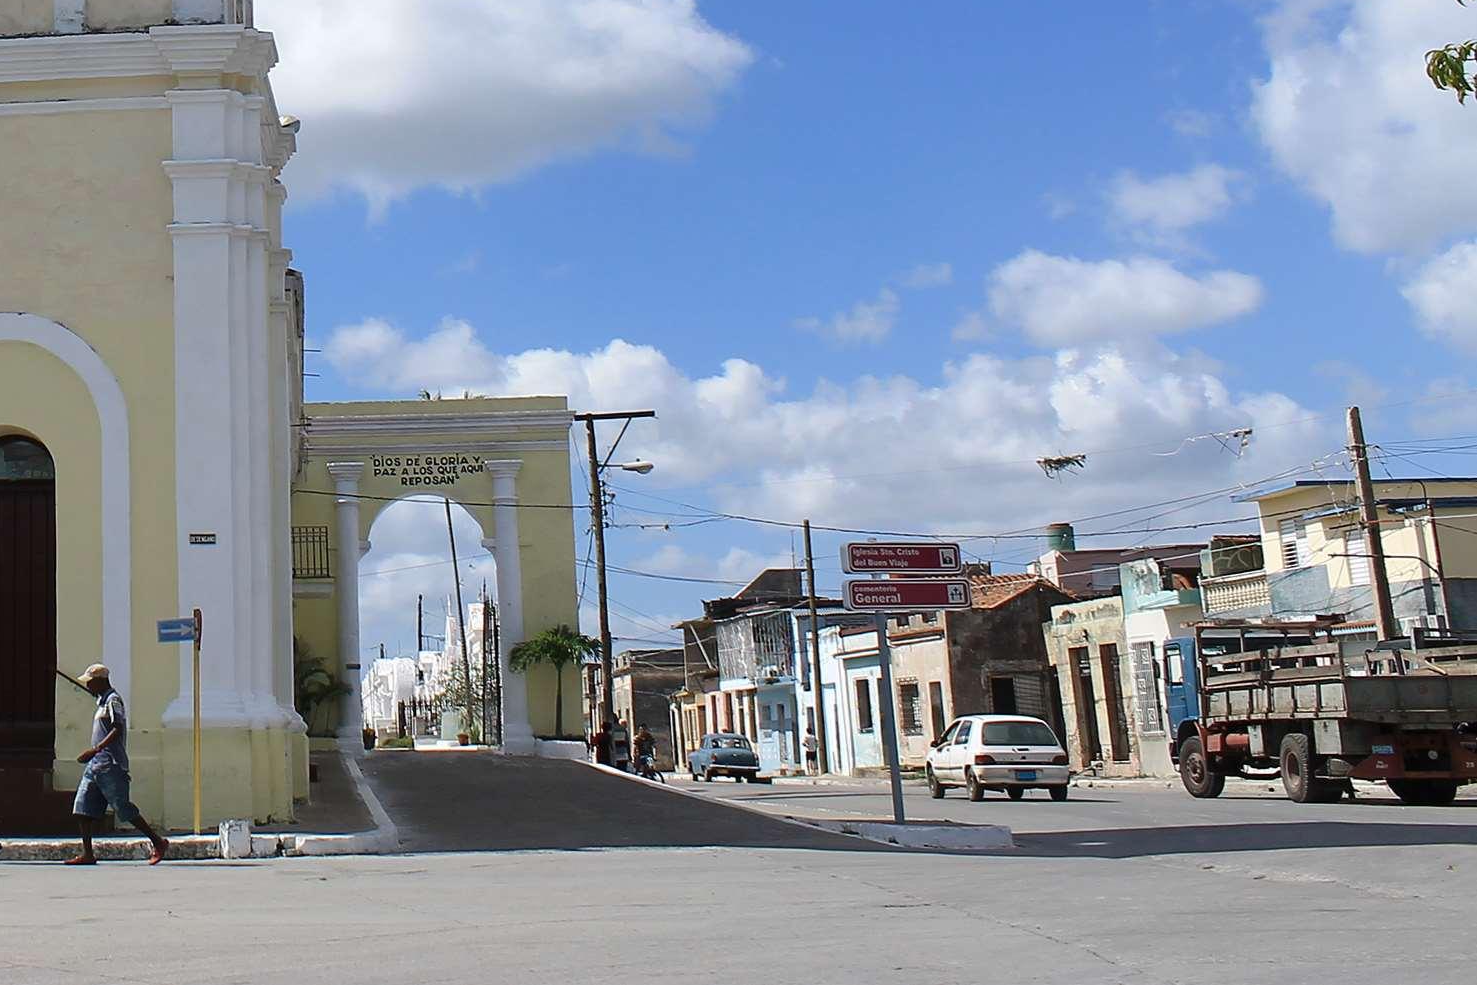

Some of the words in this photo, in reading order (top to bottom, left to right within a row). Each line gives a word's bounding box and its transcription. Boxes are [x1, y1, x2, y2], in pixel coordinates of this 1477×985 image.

[425, 454, 469, 466] GLORIA
[374, 468, 397, 477] PAZ
[401, 467, 409, 475] A
[413, 466, 434, 475] LOS
[437, 465, 457, 475] QUE
[853, 548, 879, 557] Iglesia
[896, 548, 920, 556] Cristo
[889, 559, 908, 567] Viaje
[856, 593, 901, 603] General
